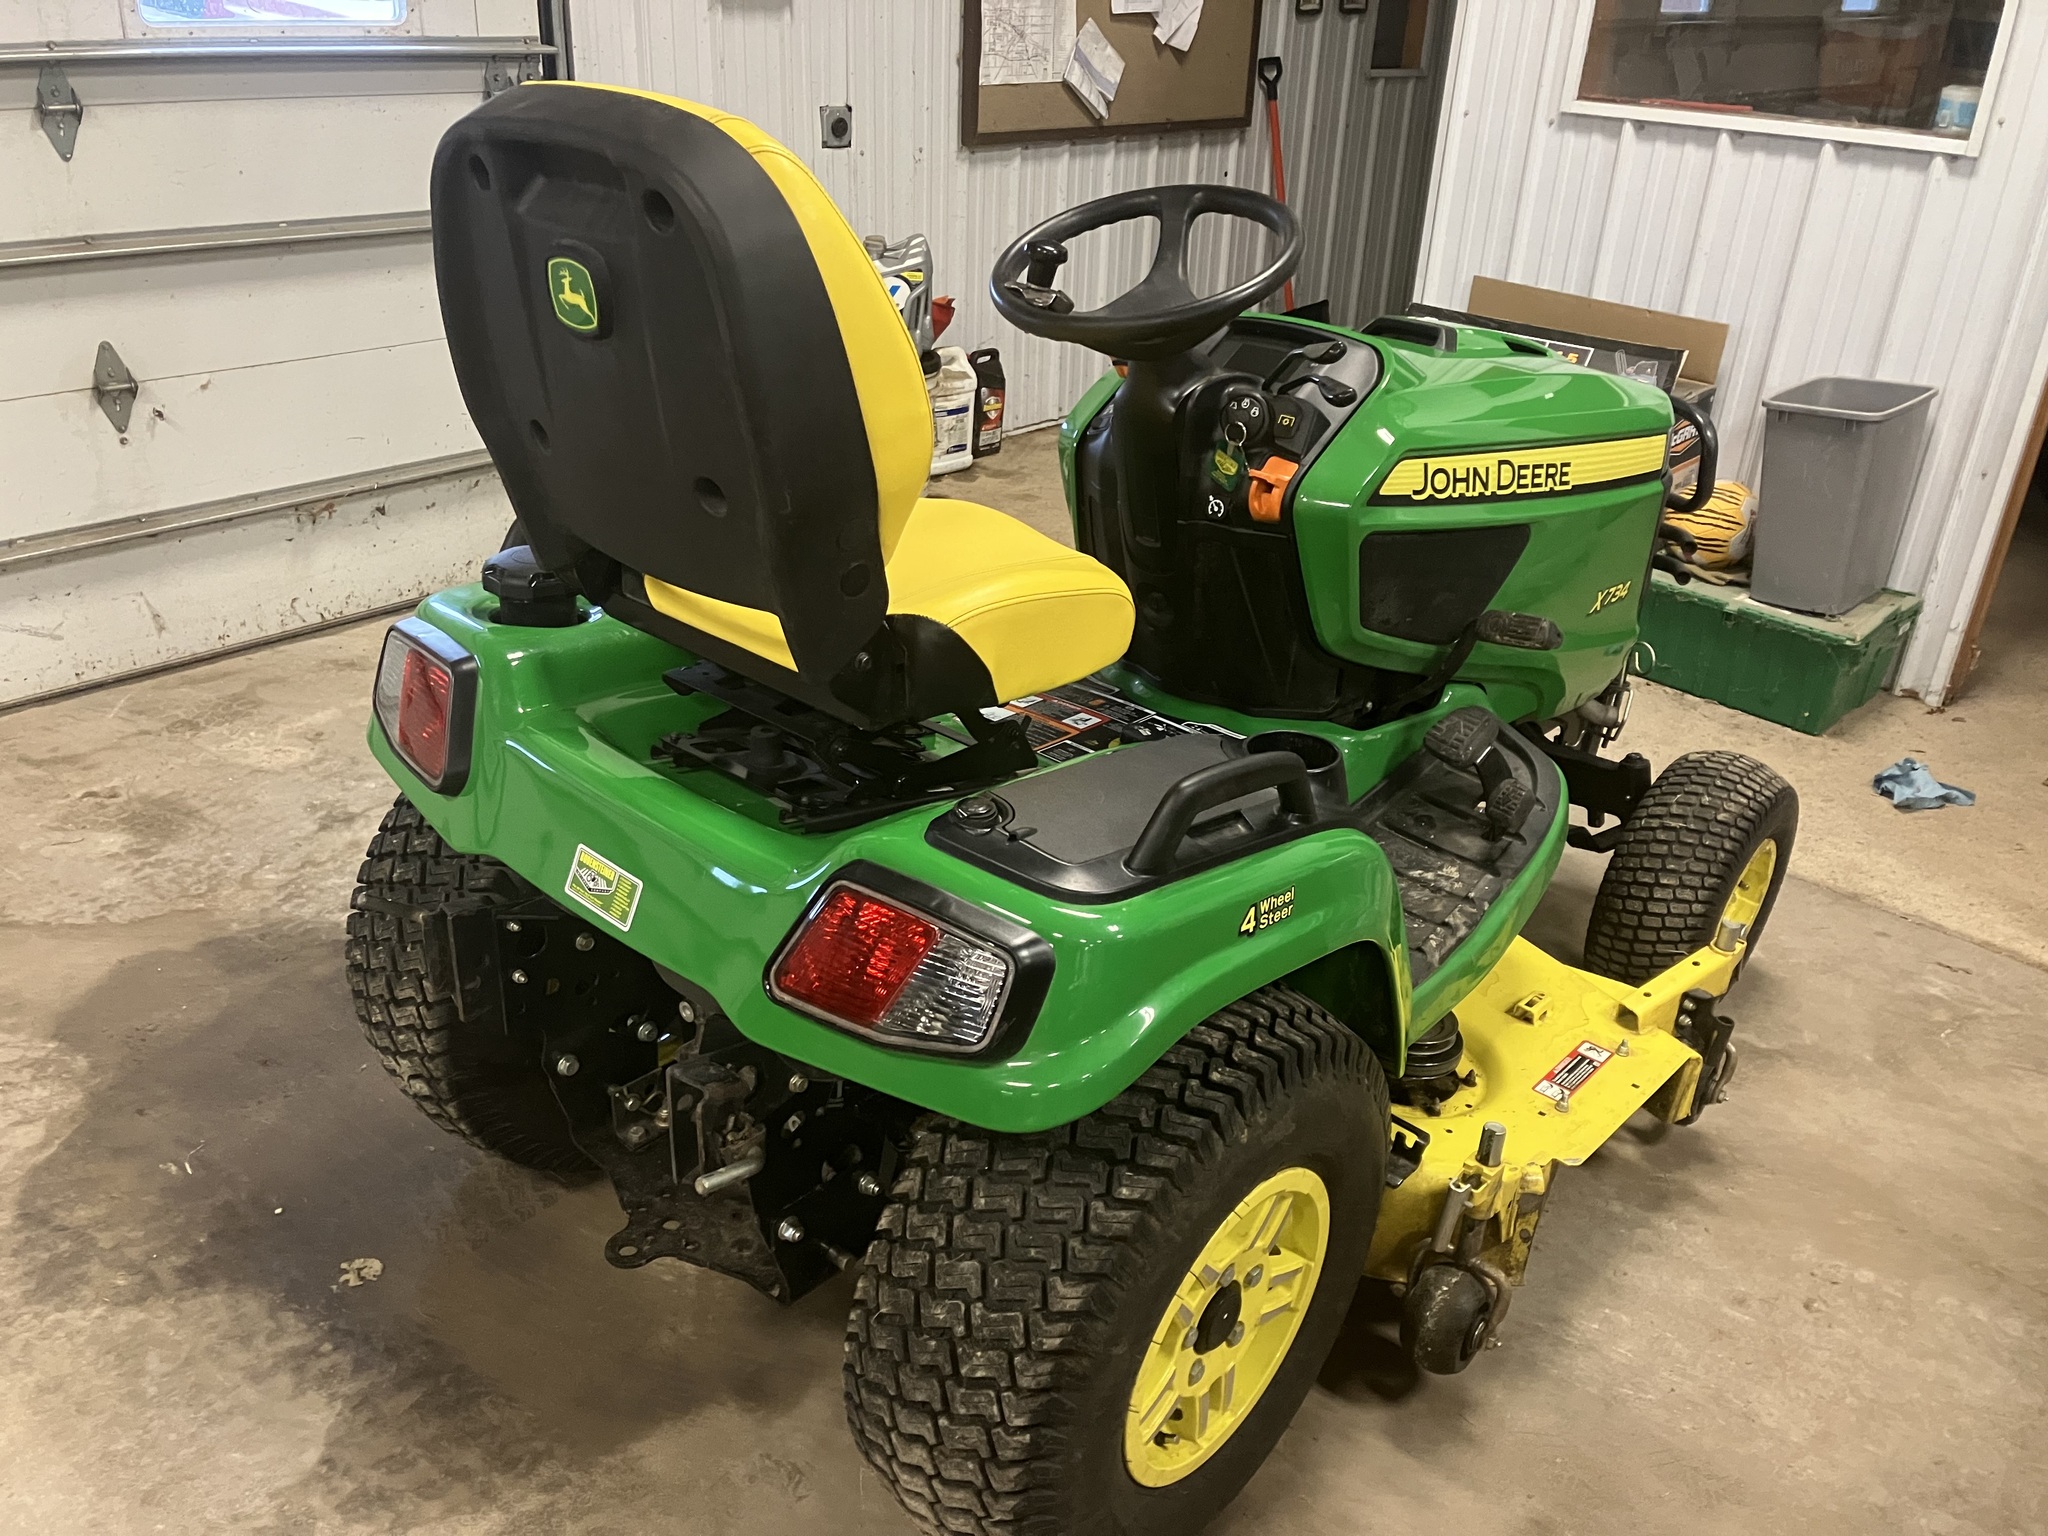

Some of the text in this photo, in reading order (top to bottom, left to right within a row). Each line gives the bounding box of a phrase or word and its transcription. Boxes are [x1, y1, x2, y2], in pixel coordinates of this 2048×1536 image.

[1411, 459, 1572, 496] JOHN DEERE
[1589, 580, 1632, 614] X734
[1239, 885, 1295, 935] 4 Wheel
[1259, 904, 1294, 929] Steer
